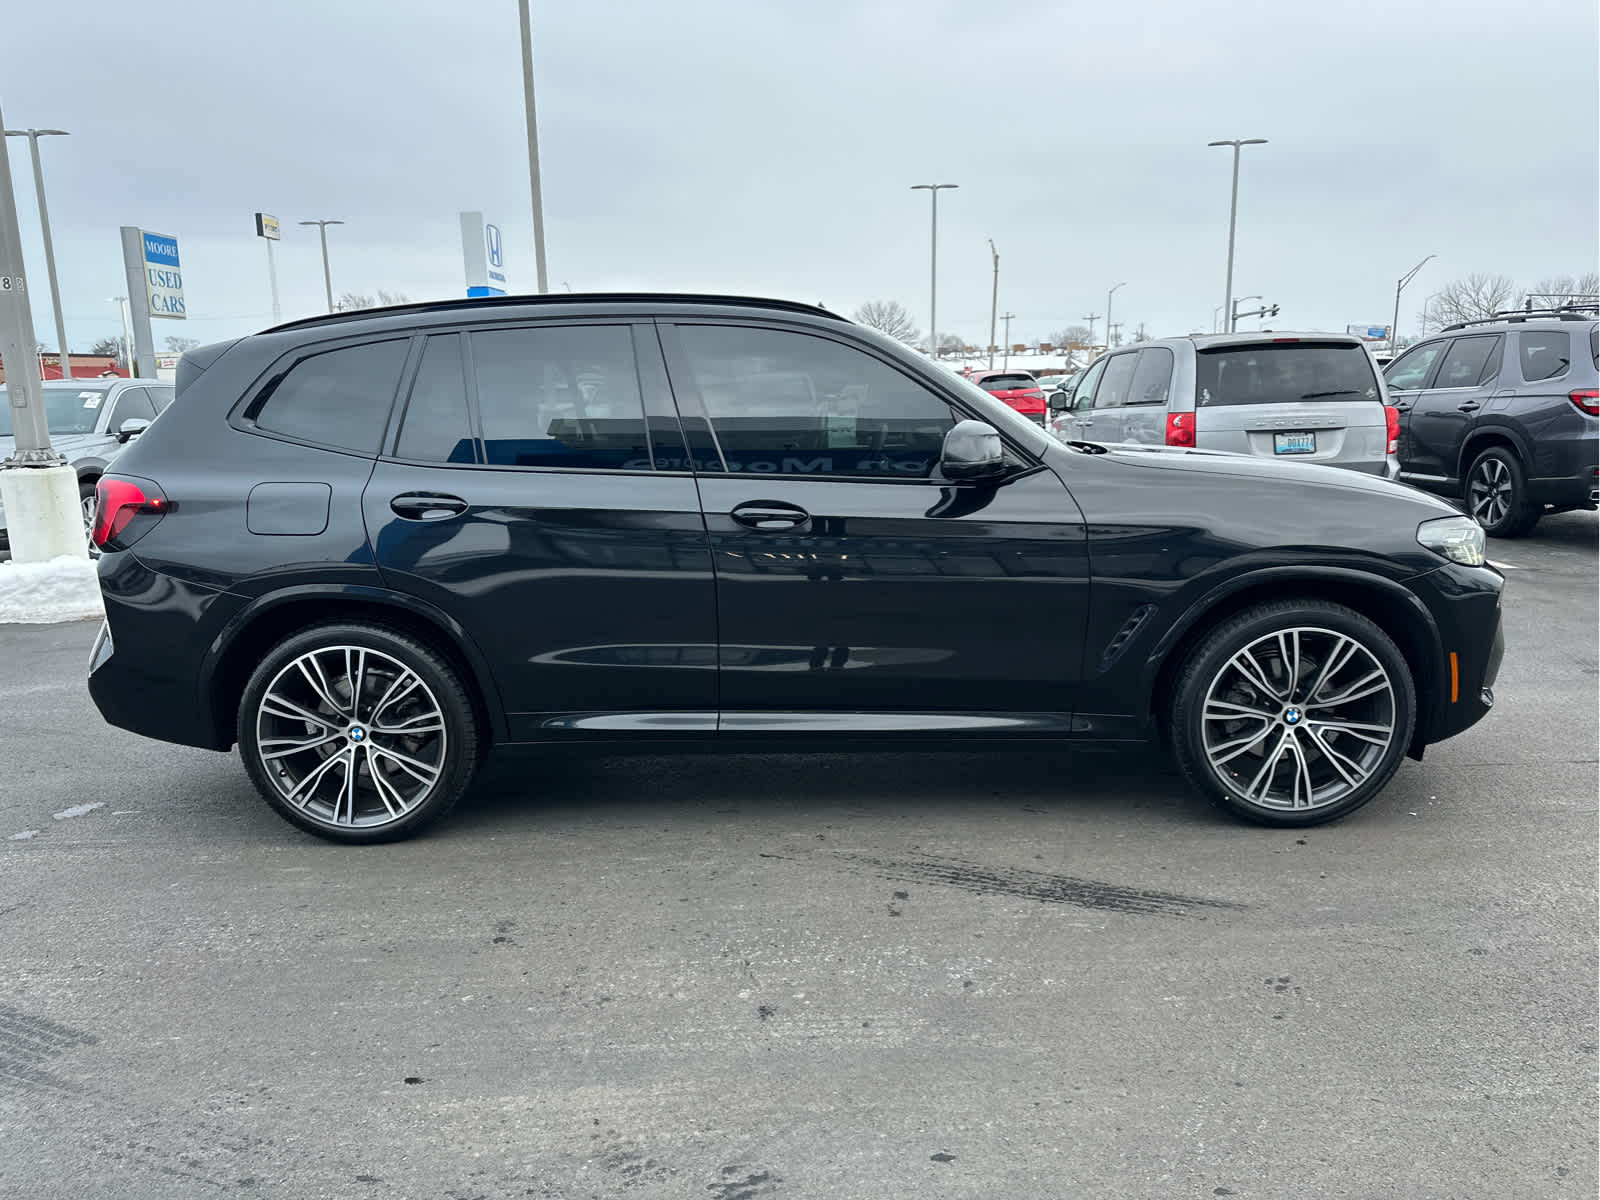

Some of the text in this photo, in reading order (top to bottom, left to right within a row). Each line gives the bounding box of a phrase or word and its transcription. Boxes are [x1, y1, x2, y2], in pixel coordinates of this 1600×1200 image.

[145, 240, 177, 256] MOORE
[3, 278, 11, 289] 8
[148, 268, 182, 289] USED
[152, 293, 185, 313] CARS
